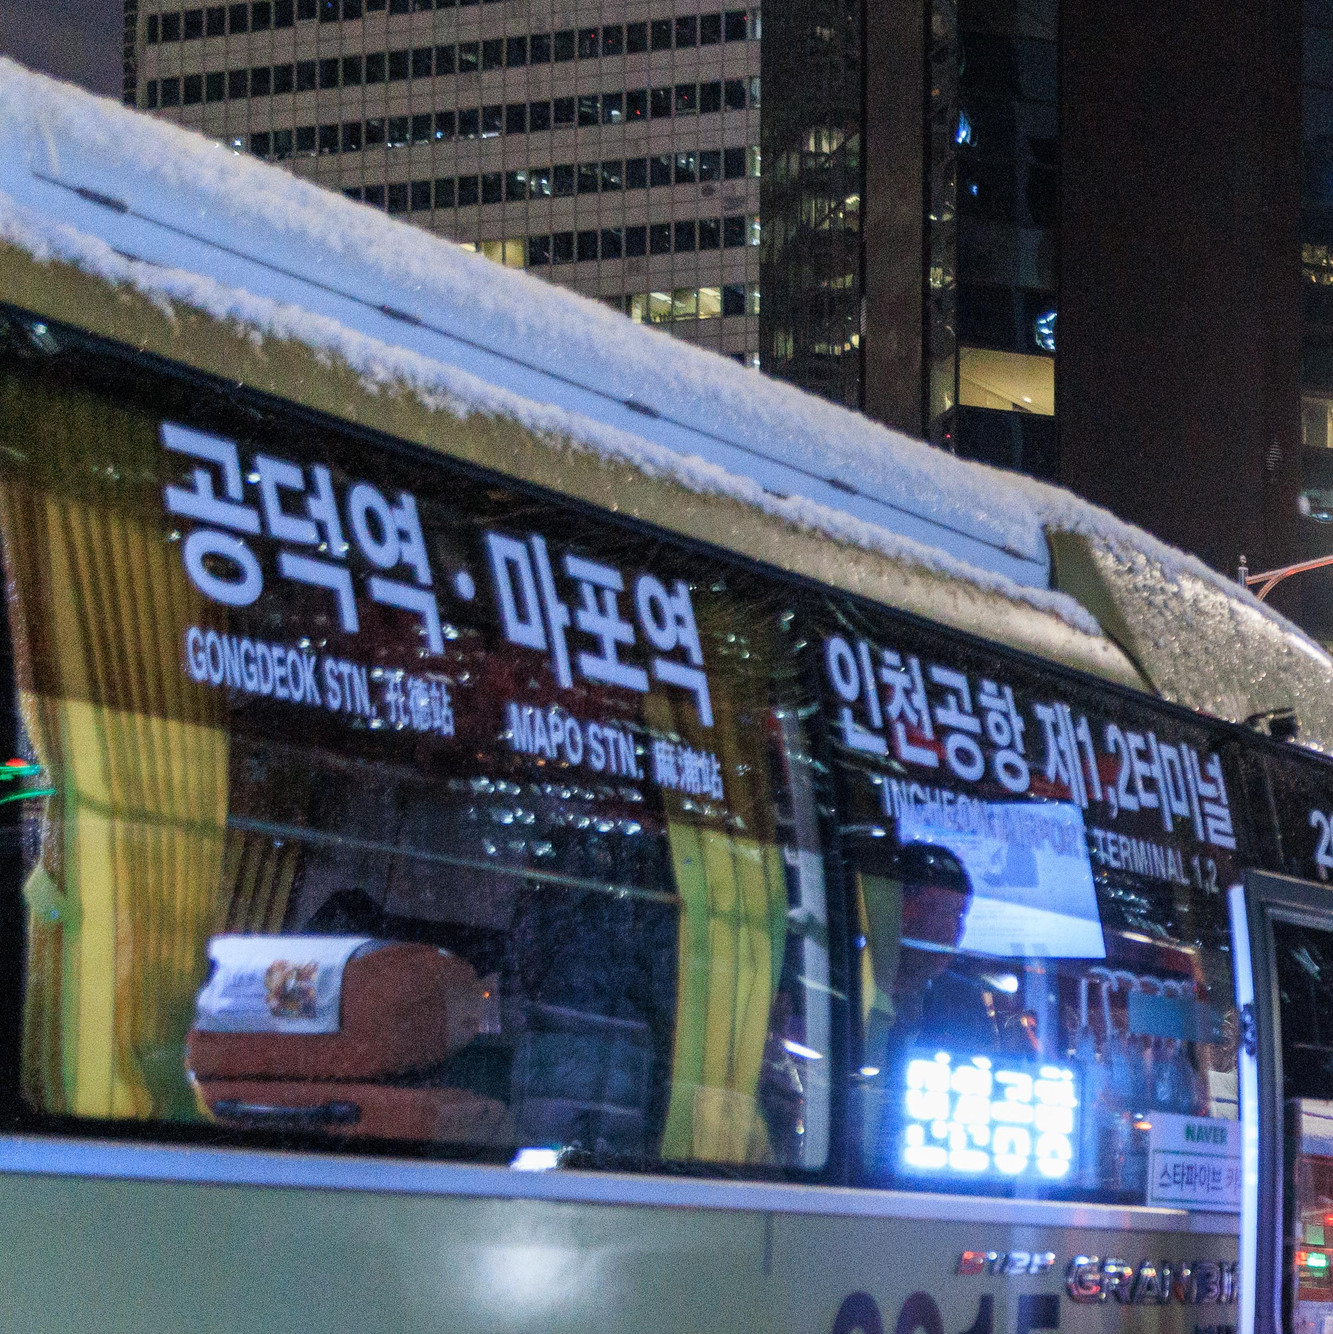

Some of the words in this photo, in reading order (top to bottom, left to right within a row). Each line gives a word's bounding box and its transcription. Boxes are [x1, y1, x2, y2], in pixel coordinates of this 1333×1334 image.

[161, 422, 444, 654] 공덕역
[487, 531, 714, 726] 마포역
[186, 626, 321, 707] GONGDEOK
[323, 656, 378, 717] STN.
[508, 703, 583, 766] MAPO
[586, 723, 644, 780] STN.
[827, 637, 1031, 793] 인천공항
[1093, 829, 1190, 886] TERMINAL
[1185, 1124, 1228, 1145] NAVER
